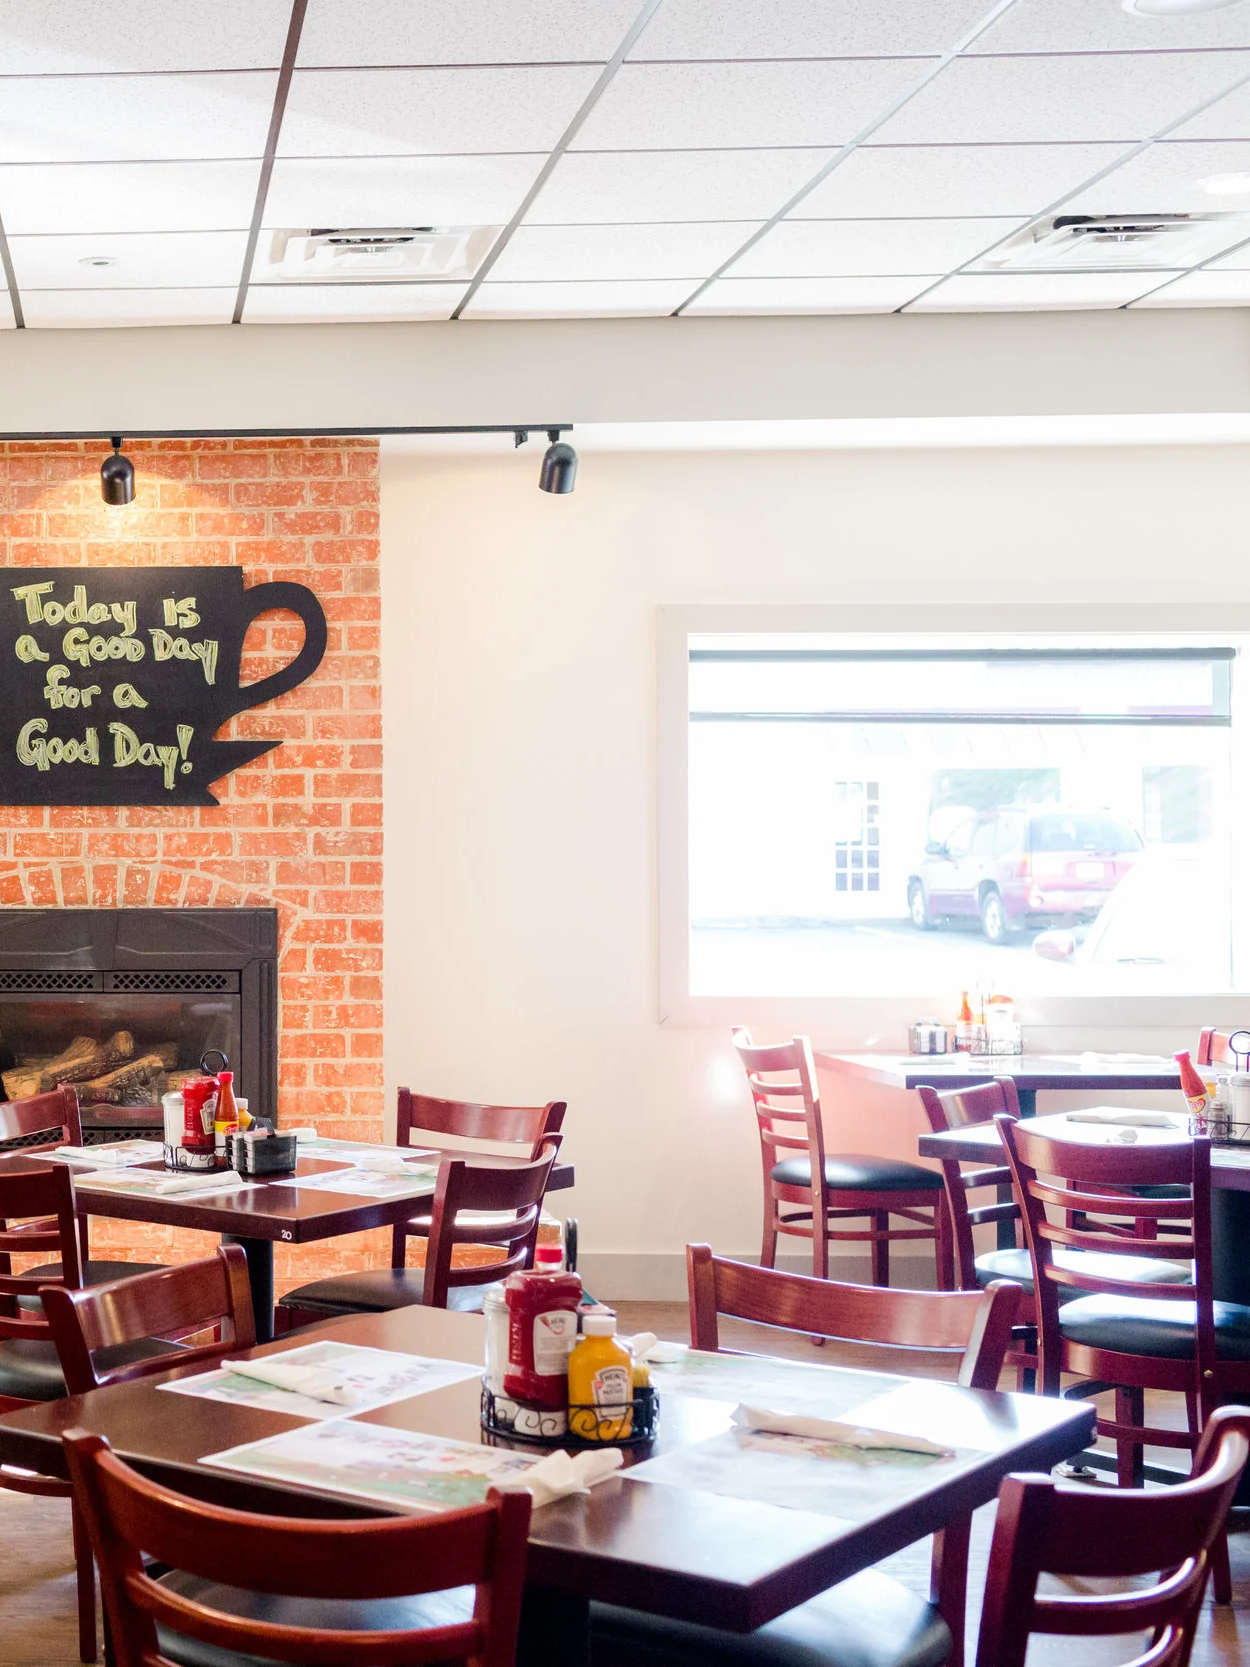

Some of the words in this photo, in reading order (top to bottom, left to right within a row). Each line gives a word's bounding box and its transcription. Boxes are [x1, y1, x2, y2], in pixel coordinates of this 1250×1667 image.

[10, 581, 137, 637] Today
[14, 634, 50, 663] a
[147, 628, 219, 686] Day
[43, 664, 102, 710] for
[112, 683, 149, 709] a
[16, 717, 101, 772] Good
[107, 722, 195, 790] Day!
[281, 1229, 293, 1240] 20
